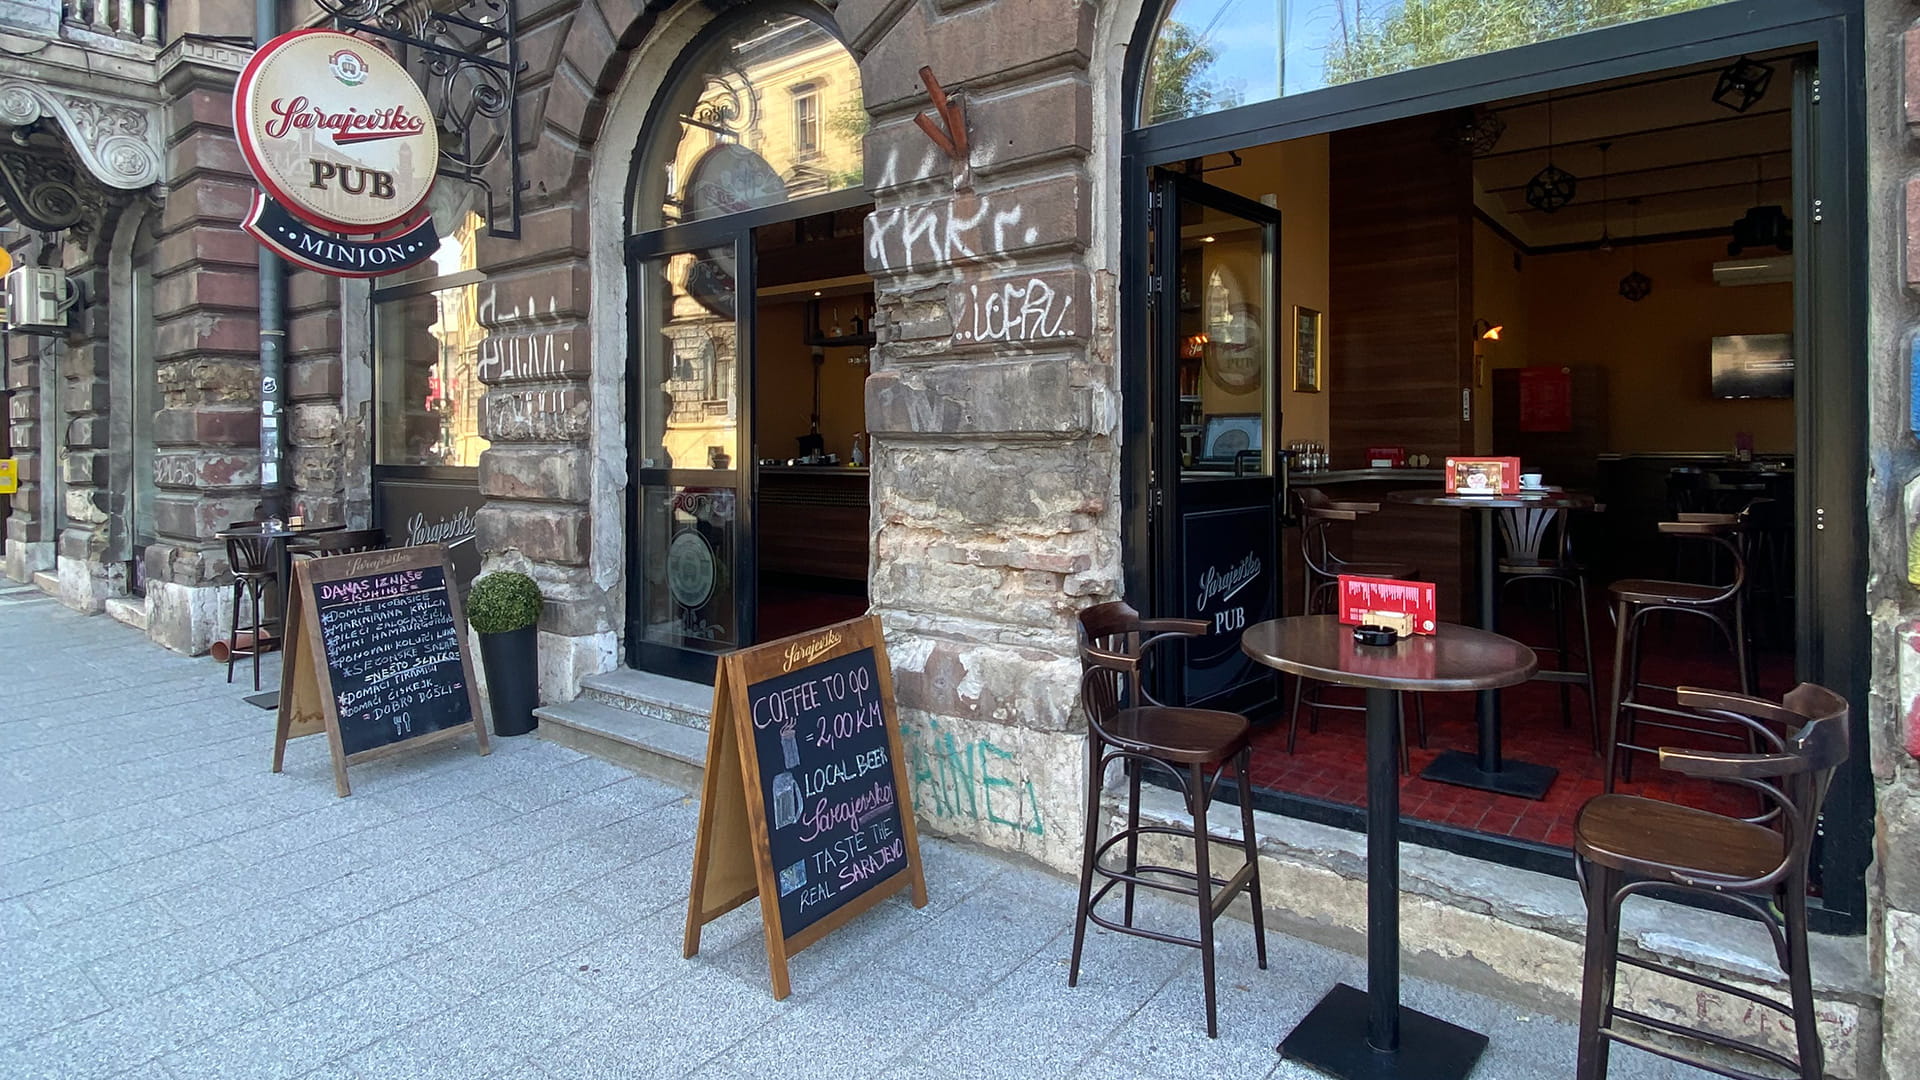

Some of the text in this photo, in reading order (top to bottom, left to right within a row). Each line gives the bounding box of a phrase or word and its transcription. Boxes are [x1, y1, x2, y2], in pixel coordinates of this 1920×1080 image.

[265, 96, 426, 145] Sarajevsko
[309, 157, 396, 201] PUB
[298, 232, 408, 268] MINJON
[320, 579, 371, 600] DANAS
[378, 592, 431, 611] KOBASICE
[1197, 550, 1262, 612] Sarajevsko
[332, 598, 446, 633] MARINIRANA KRILCA
[1214, 606, 1246, 636] PUB
[335, 636, 365, 657] MINI
[783, 630, 842, 673] Sarajevsko
[394, 664, 438, 685] TIRAMISU
[374, 694, 413, 721] DOBRO
[753, 680, 821, 730] COFFEE
[822, 672, 845, 703] TO
[804, 746, 888, 798] LOCAL BEER
[799, 781, 894, 843] Sarajevsko
[811, 817, 894, 875] TASTE THE
[799, 838, 904, 914] REAL SARAJEVO
